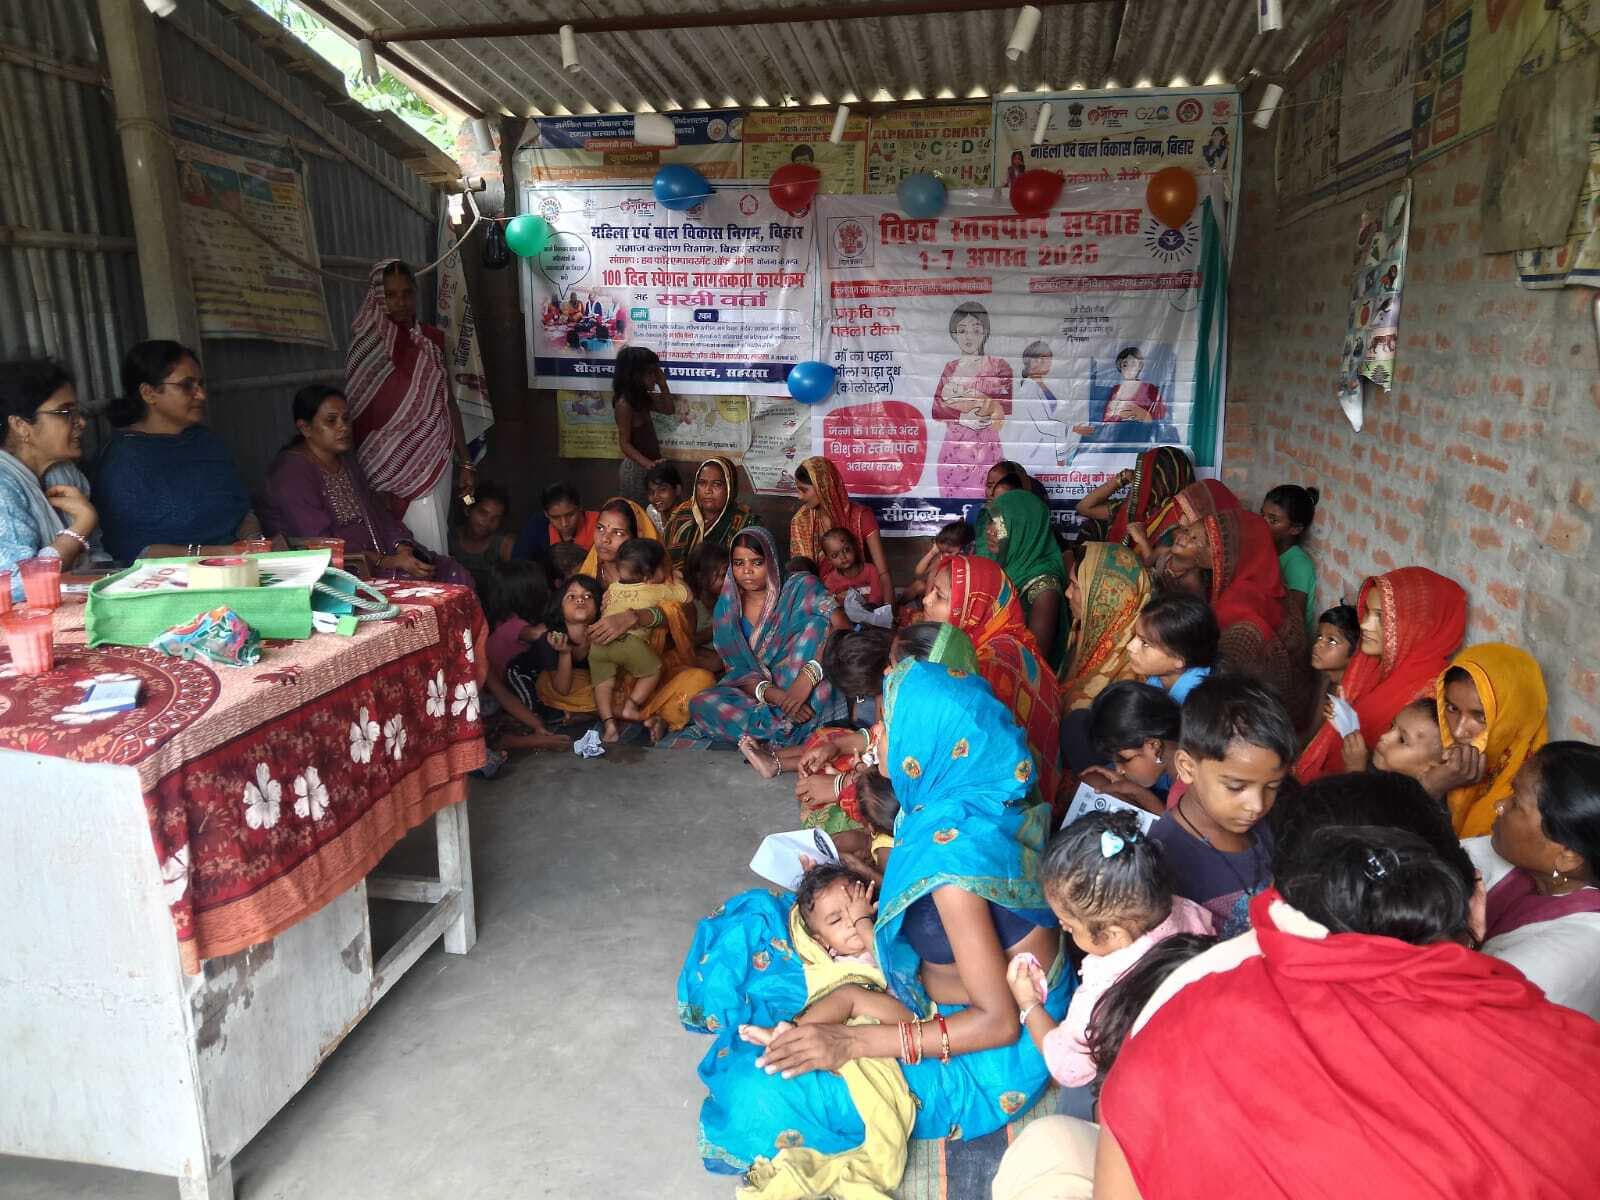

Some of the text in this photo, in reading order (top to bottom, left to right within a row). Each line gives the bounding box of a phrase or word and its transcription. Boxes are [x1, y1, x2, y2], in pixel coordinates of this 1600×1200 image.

[872, 127, 986, 140] ALPHABET CHART
[930, 141, 942, 155] C
[961, 140, 974, 154] D
[1100, 138, 1131, 157] विकास
[1167, 136, 1194, 155] बिहार
[591, 222, 804, 242] महिला एवं बाल विकास निगम, बिहार
[879, 209, 1142, 245] विश्व स्तनपान सप्ताह
[616, 244, 645, 253] समाज
[647, 244, 680, 253] कल्याण
[747, 244, 780, 253] सरकार
[967, 248, 1026, 268] अगस्त
[1039, 243, 1098, 267] 2025
[602, 269, 621, 286] 100
[625, 267, 648, 287] दिन
[651, 267, 688, 287] स्पेशल
[656, 291, 716, 306] सखी
[876, 306, 896, 317] का
[849, 351, 864, 361] का
[867, 351, 894, 362] पहला
[669, 367, 720, 379] प्रशासन,
[726, 368, 769, 378] सहरसा
[834, 364, 859, 377] पीला
[885, 366, 902, 382] दूध
[887, 424, 897, 436] के
[899, 423, 920, 436] अंदर
[831, 441, 851, 457] शिशु
[852, 442, 865, 454] को
[1070, 471, 1090, 485] शिशु
[1092, 472, 1105, 482] को
[1055, 484, 1064, 494] के
[1065, 484, 1084, 495] पहले
[882, 503, 941, 521] सौजन्य
